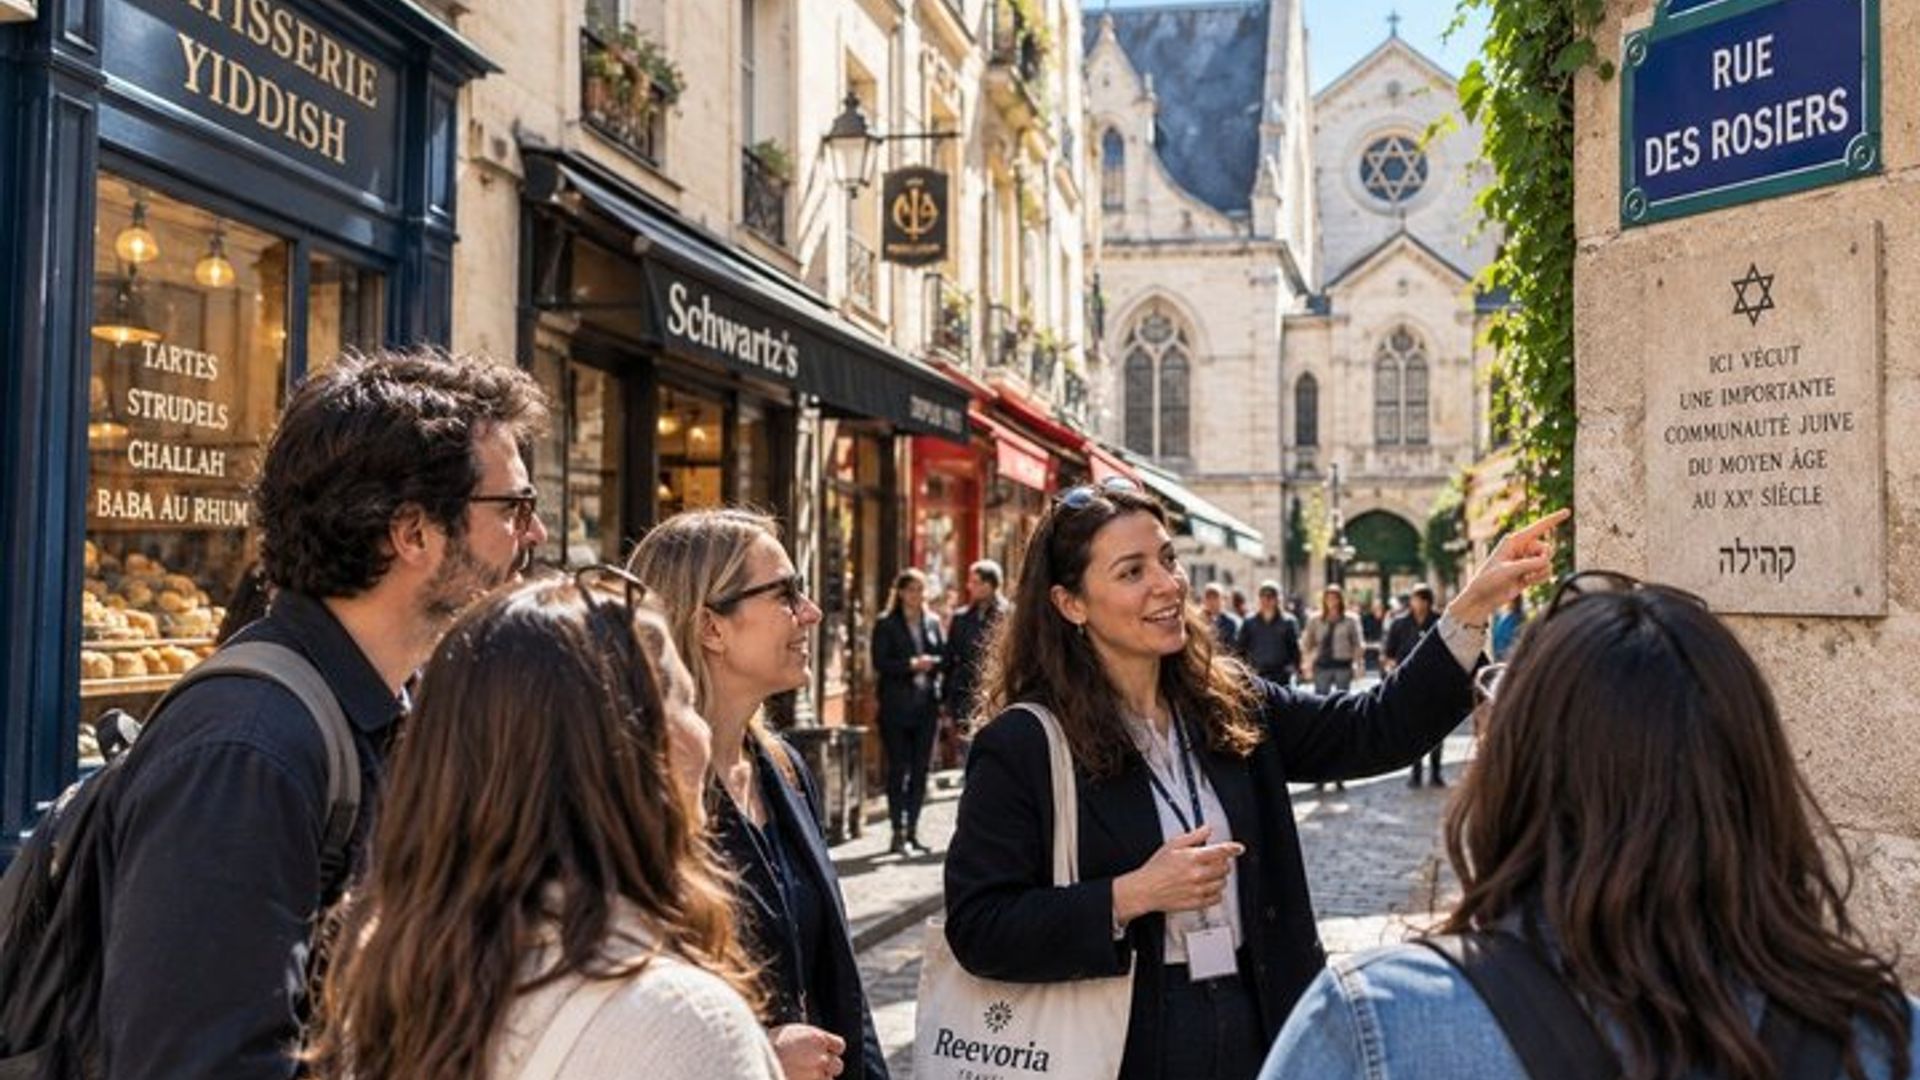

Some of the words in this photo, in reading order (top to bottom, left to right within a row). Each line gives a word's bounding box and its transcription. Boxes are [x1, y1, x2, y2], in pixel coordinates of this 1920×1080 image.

[189, 0, 378, 108] ISSERIE
[1712, 34, 1775, 90] RUE
[177, 33, 346, 164] YIDDISH
[1644, 126, 1700, 176] DES
[1711, 86, 1849, 160] ROSIERS
[667, 282, 799, 378] Schwartz's
[142, 340, 218, 381] TARTES
[1709, 353, 1733, 374] ICI
[127, 388, 229, 430] STRUDELS
[1680, 390, 1714, 410] UNE
[1721, 376, 1836, 407] IMPORTANTE
[1799, 411, 1855, 435] JUIVE
[128, 439, 226, 477] CHALLAH
[1687, 457, 1713, 477] DU
[1720, 452, 1782, 475] MOYEN
[96, 488, 154, 519] BABA
[160, 493, 189, 522] AU
[194, 497, 250, 527] RHUM
[1692, 489, 1716, 510] AU
[1719, 537, 1796, 583] קהילה
[933, 1027, 1050, 1072] Reevoria
